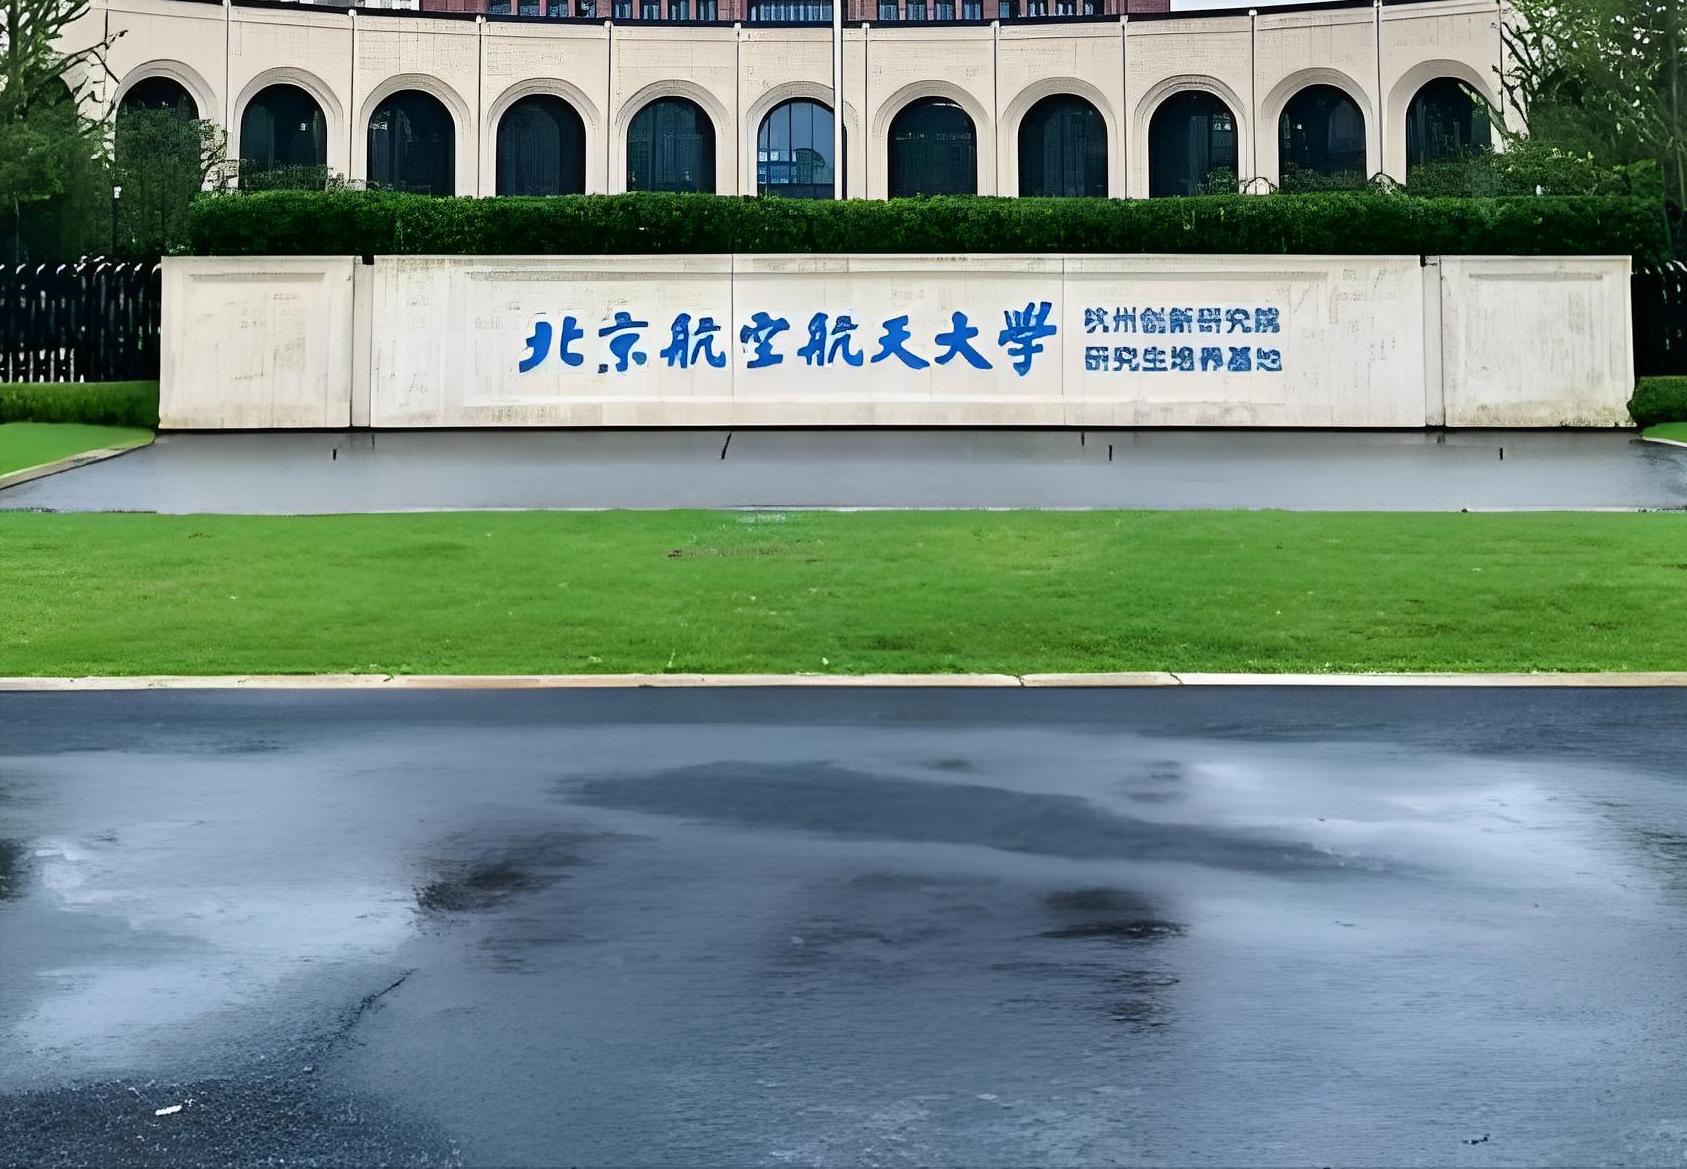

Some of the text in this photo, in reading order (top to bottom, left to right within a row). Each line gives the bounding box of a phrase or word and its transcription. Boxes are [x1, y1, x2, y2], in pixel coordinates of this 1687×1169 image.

[519, 302, 1056, 376] 北京航空航天大学
